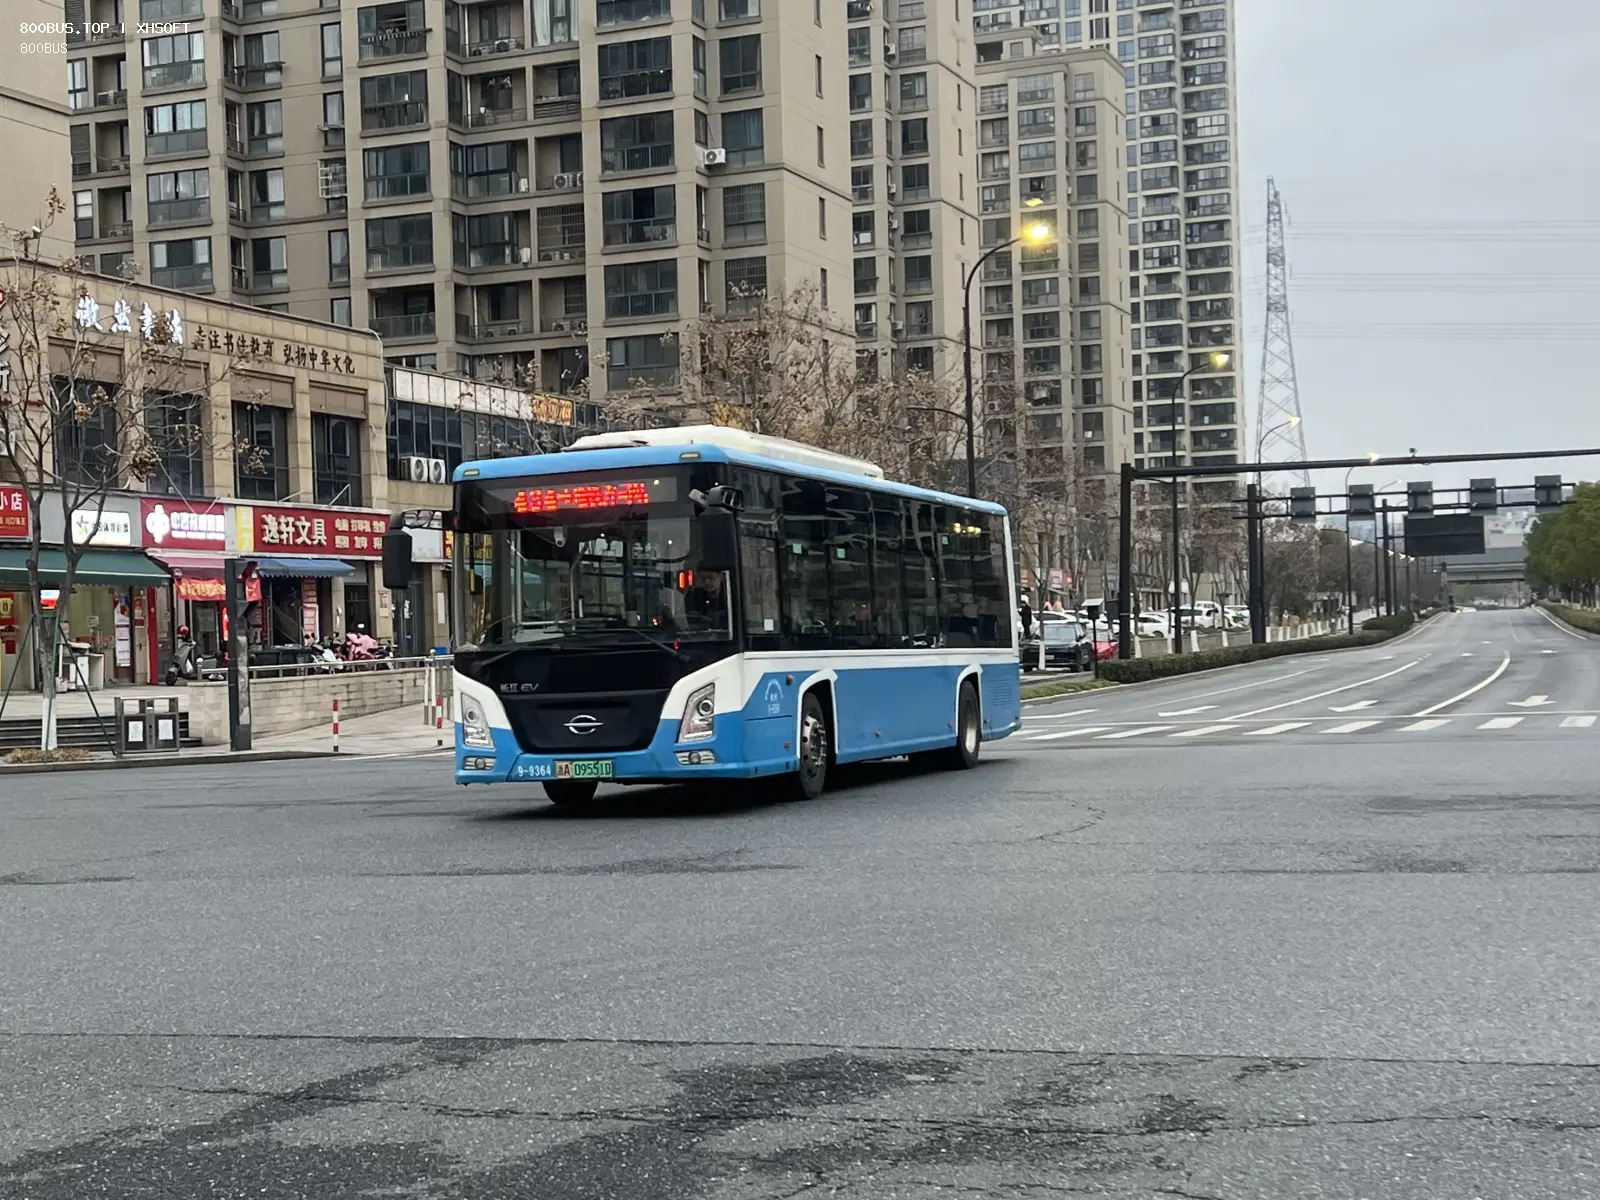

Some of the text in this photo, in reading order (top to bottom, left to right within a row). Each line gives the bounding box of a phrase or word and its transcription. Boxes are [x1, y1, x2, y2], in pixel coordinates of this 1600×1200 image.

[283, 344, 355, 375] 弘扬中华文化
[261, 514, 327, 546] 逸轩文具
[517, 764, 552, 777] 9-9364
[574, 763, 611, 776] 09551D
